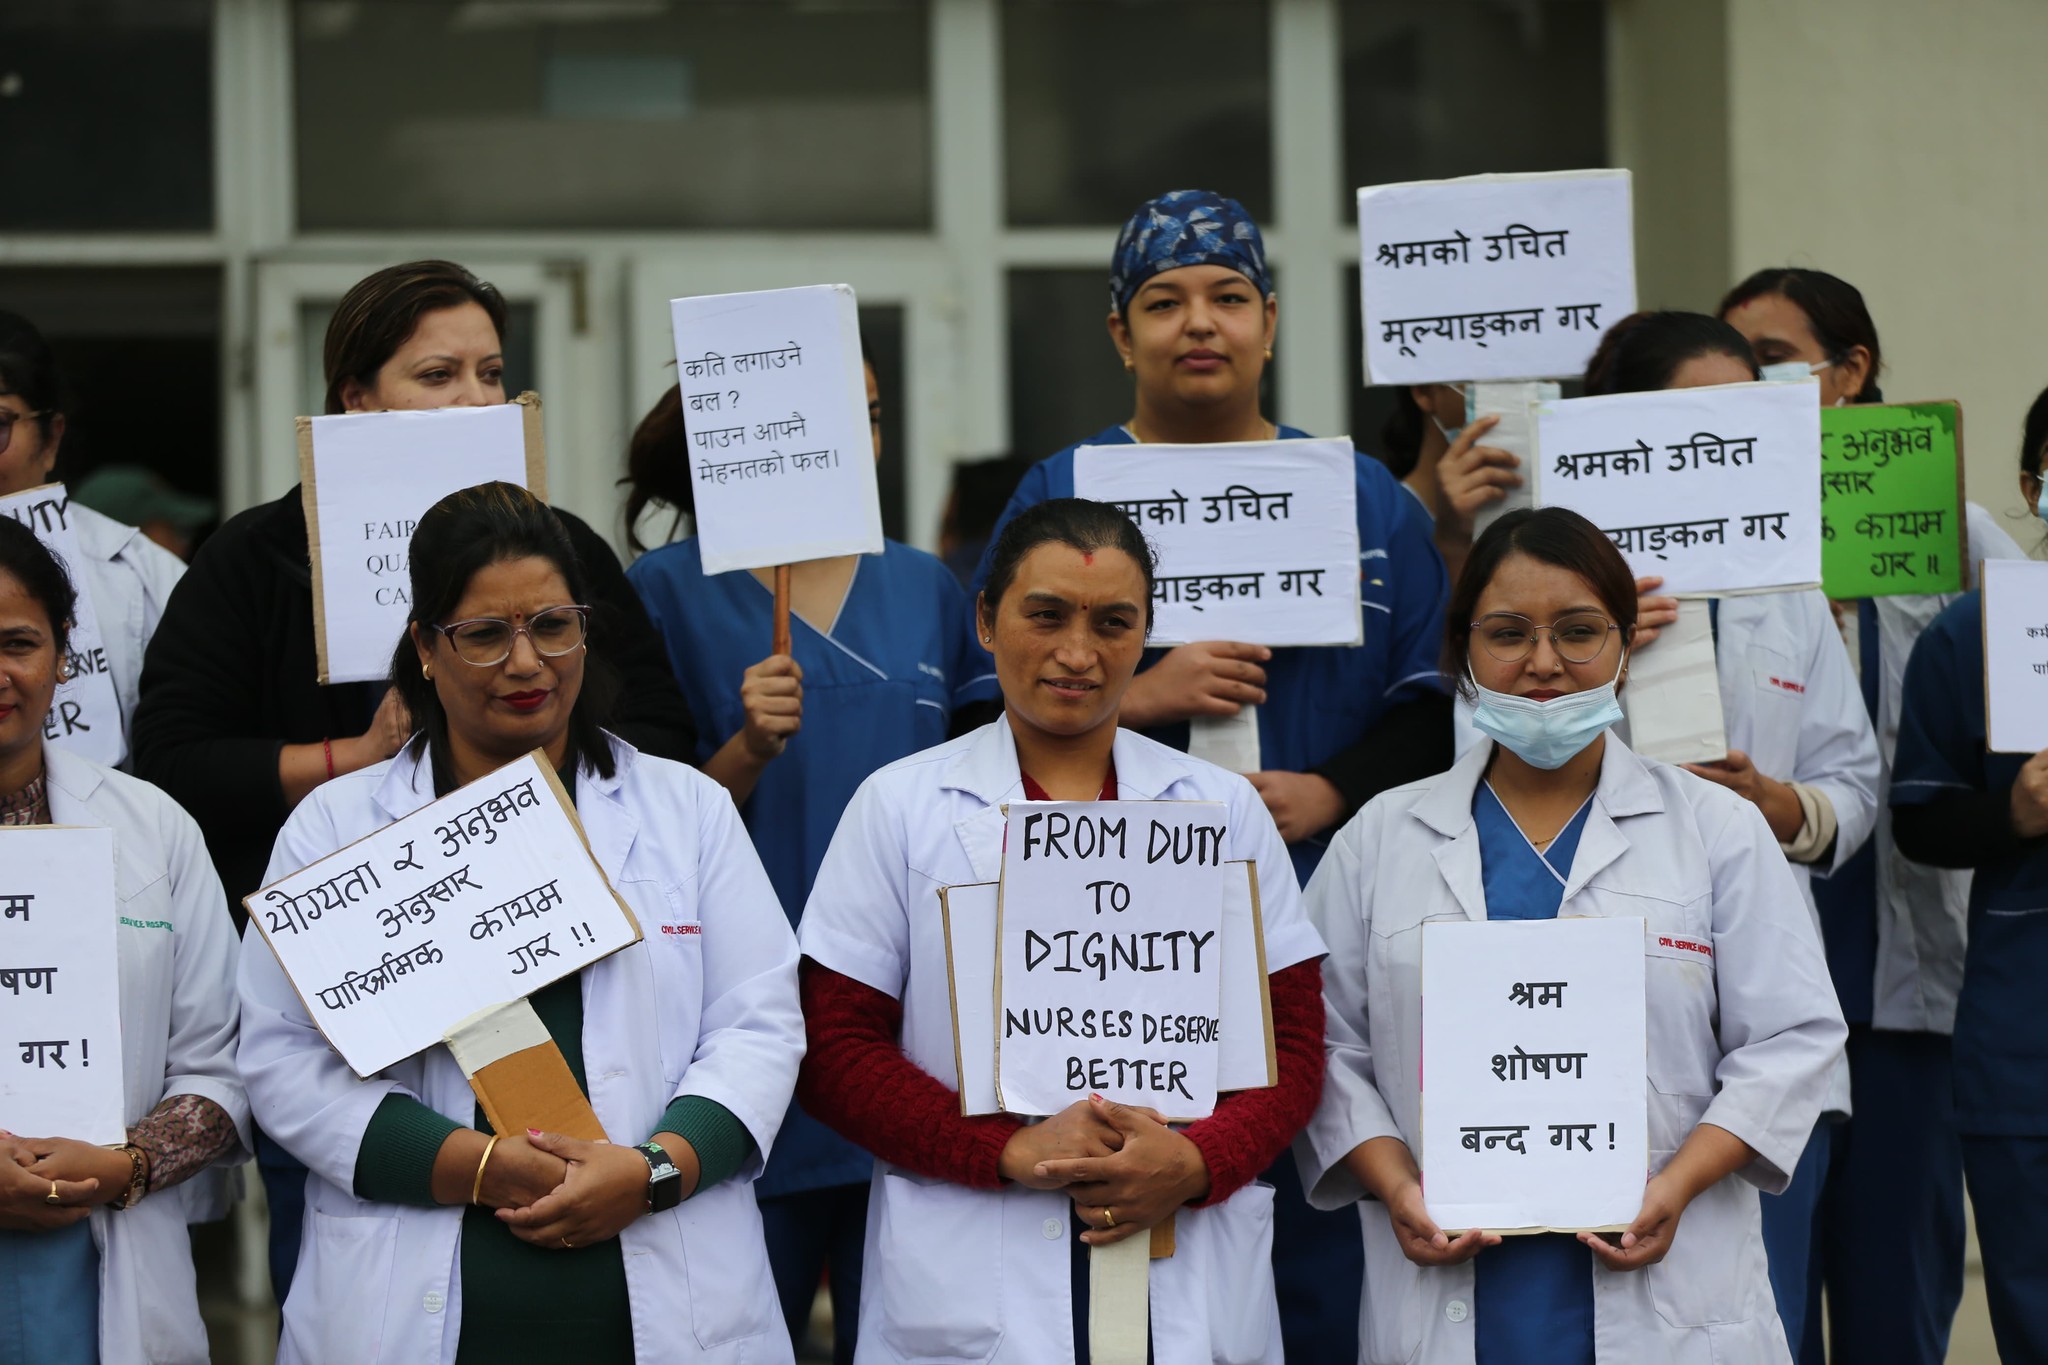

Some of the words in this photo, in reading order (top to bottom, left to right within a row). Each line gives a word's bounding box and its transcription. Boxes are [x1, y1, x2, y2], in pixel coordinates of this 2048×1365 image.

[1375, 229, 1472, 269] श्रमको
[1482, 223, 1570, 263] उचित
[1380, 307, 1545, 358] मूल्याङ्कन
[1555, 303, 1602, 331] गर
[683, 351, 726, 379] कति
[731, 341, 803, 374] लगाउने
[688, 392, 721, 413] बल
[693, 426, 746, 450] पाउन
[1553, 438, 1654, 481] श्रमको
[1665, 431, 1758, 467] उचित
[1838, 425, 1936, 470] अनुभव
[697, 450, 785, 485] मेहनतको
[13, 496, 69, 534] UTY
[1102, 486, 1189, 527] मको
[1201, 485, 1293, 524] उचित
[1854, 508, 1946, 543] कायम
[1600, 516, 1731, 562] याङ्कन
[1740, 512, 1790, 541] गर
[1869, 551, 1916, 578] गर
[1152, 570, 1266, 614] याङ्कन
[1277, 568, 1326, 597] गर
[1023, 812, 1126, 861] FROM
[1147, 819, 1227, 867] DUTY
[265, 861, 381, 935] योग्यता
[393, 839, 424, 871] र
[376, 864, 483, 939] अनुसार
[1085, 880, 1131, 915] TO
[0, 894, 35, 922] म
[469, 878, 563, 941] कायम
[507, 932, 561, 975] गर
[1024, 929, 1215, 982] DIGNITY
[0, 967, 58, 996] षण
[1508, 981, 1568, 1009] श्रम
[1005, 1006, 1133, 1039] NURSES
[1141, 1013, 1220, 1045] DESERVE
[18, 1040, 70, 1070] गर
[1491, 1044, 1588, 1082] शोषण
[1066, 1056, 1194, 1101] BETTER
[1459, 1125, 1530, 1155] बन्द
[1547, 1123, 1597, 1153] गर
